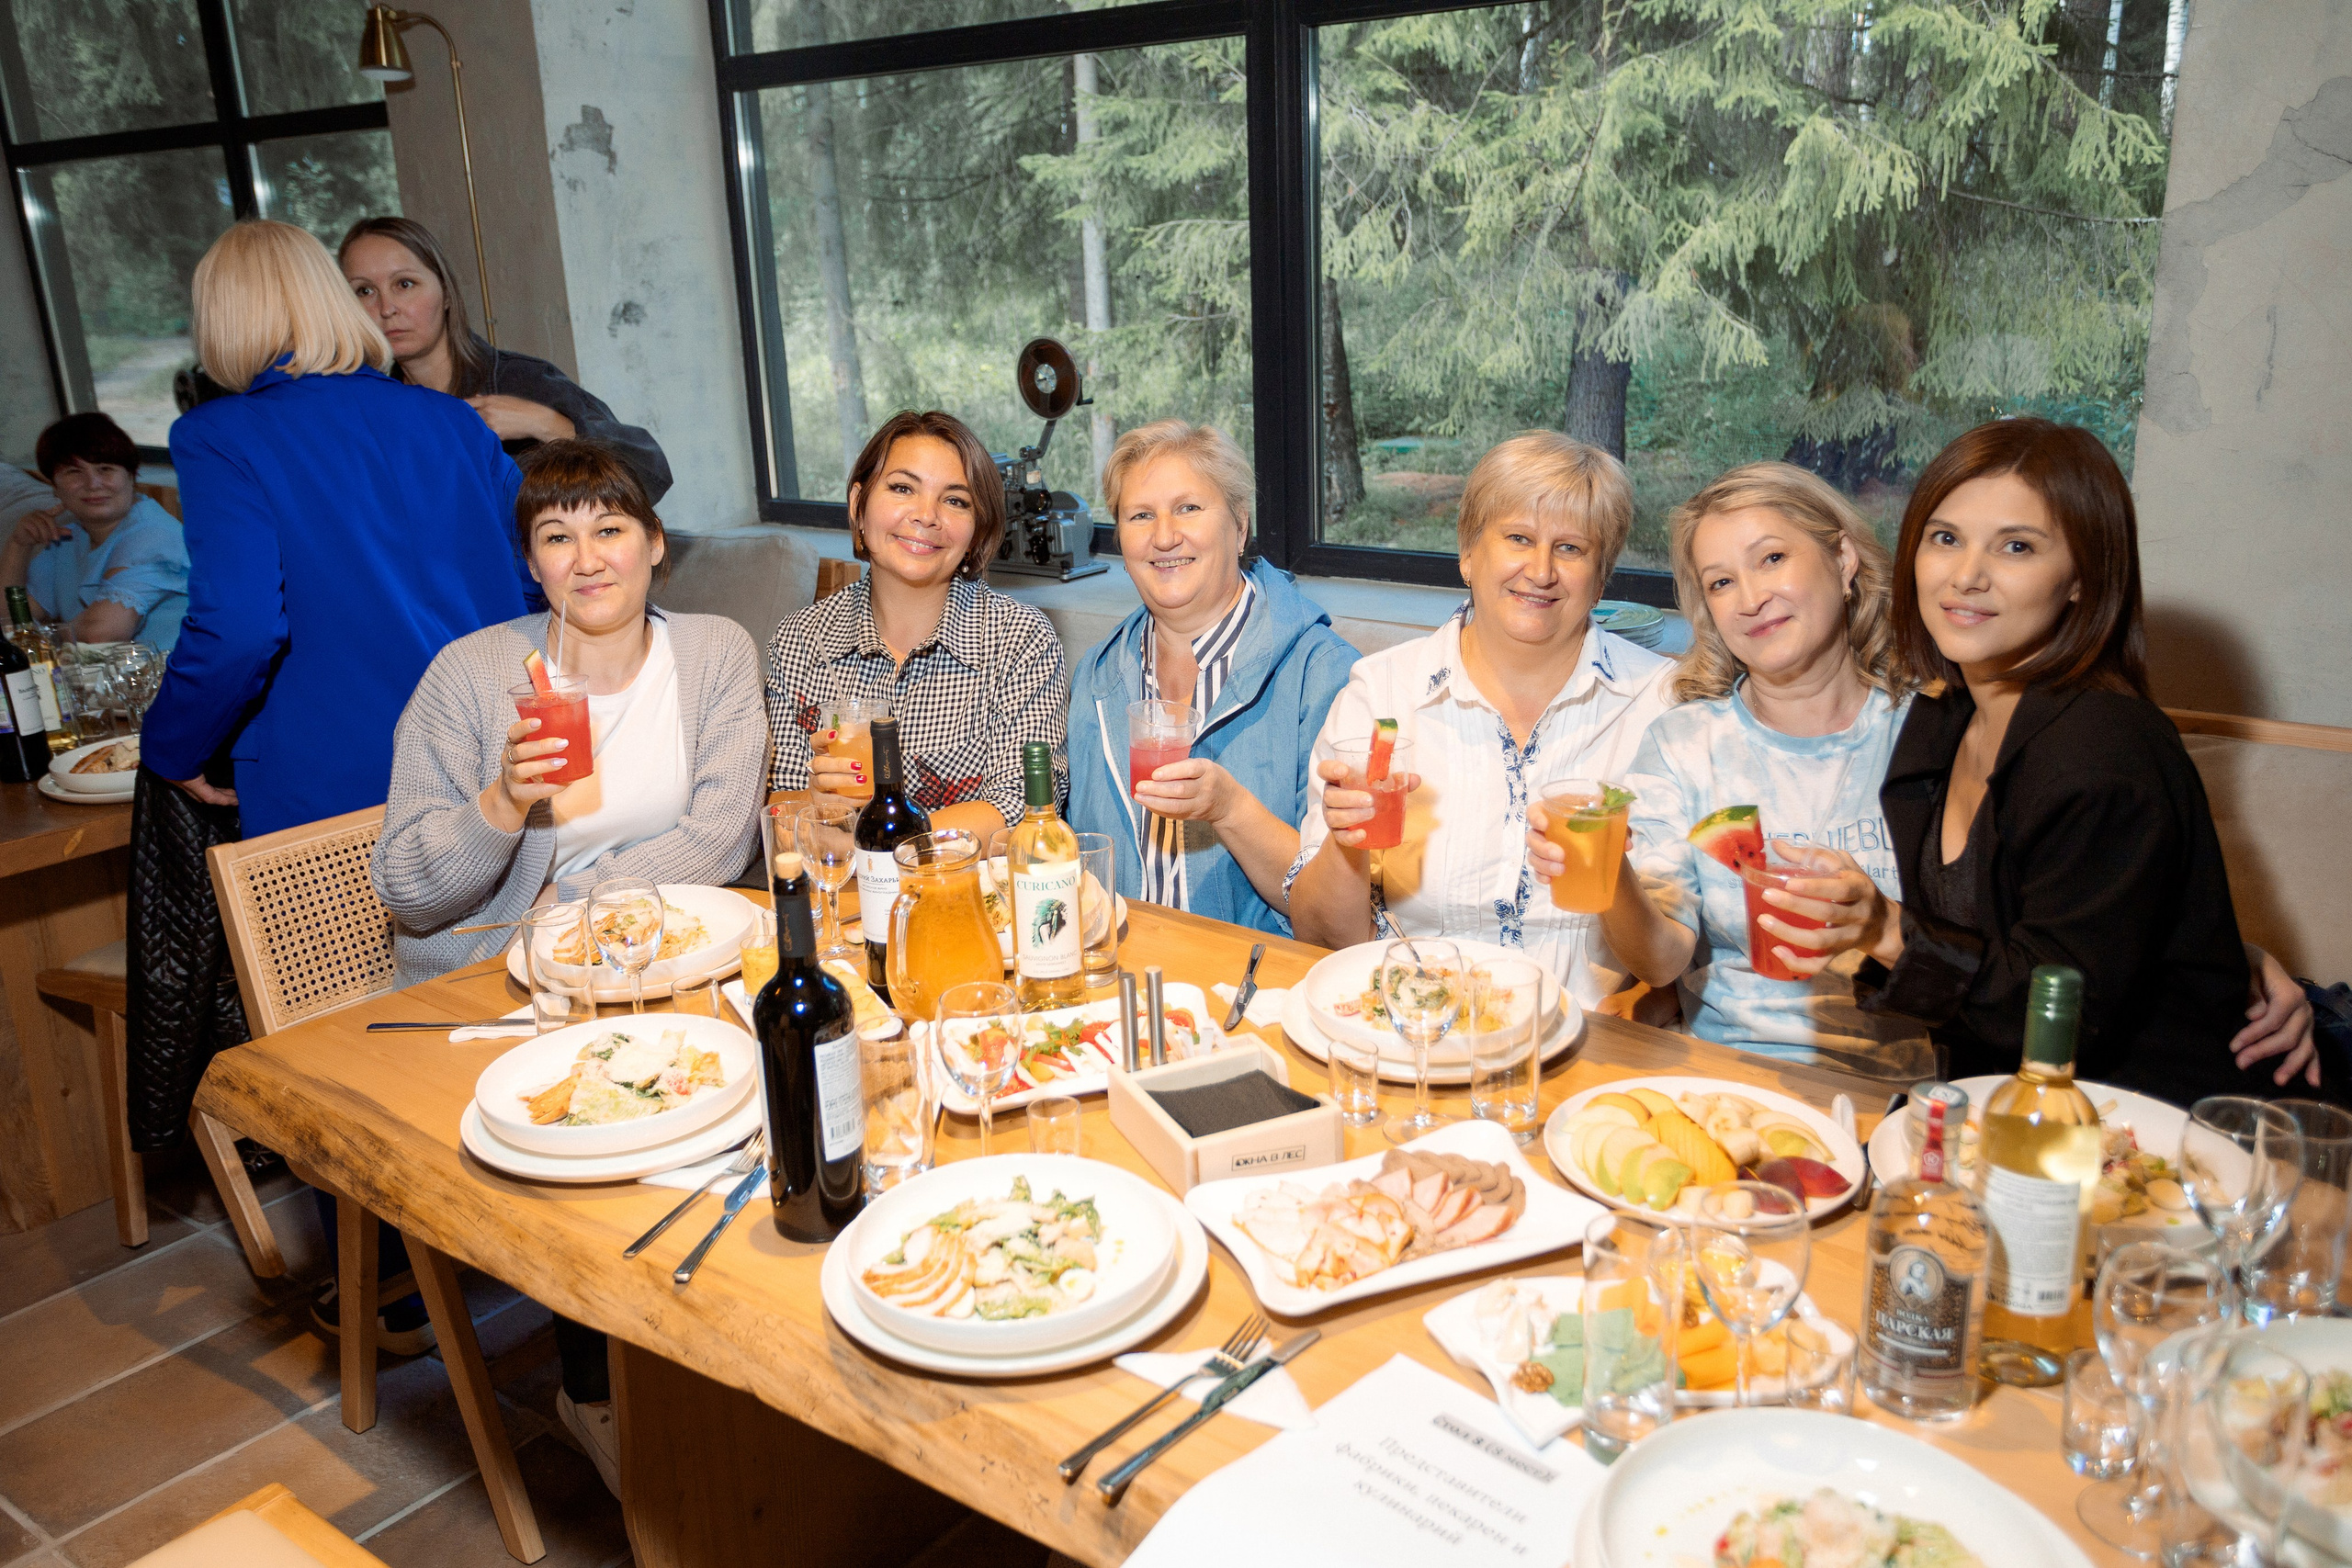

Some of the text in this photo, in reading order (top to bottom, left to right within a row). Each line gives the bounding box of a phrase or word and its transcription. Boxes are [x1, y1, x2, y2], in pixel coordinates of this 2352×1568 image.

[1016, 875, 1076, 891] CURICANO
[1022, 949, 1077, 962] SAUVIGNON BLANC
[1282, 1149, 1303, 1160] ЛЕС
[1875, 1308, 1954, 1341] ЦАРСКАЯ
